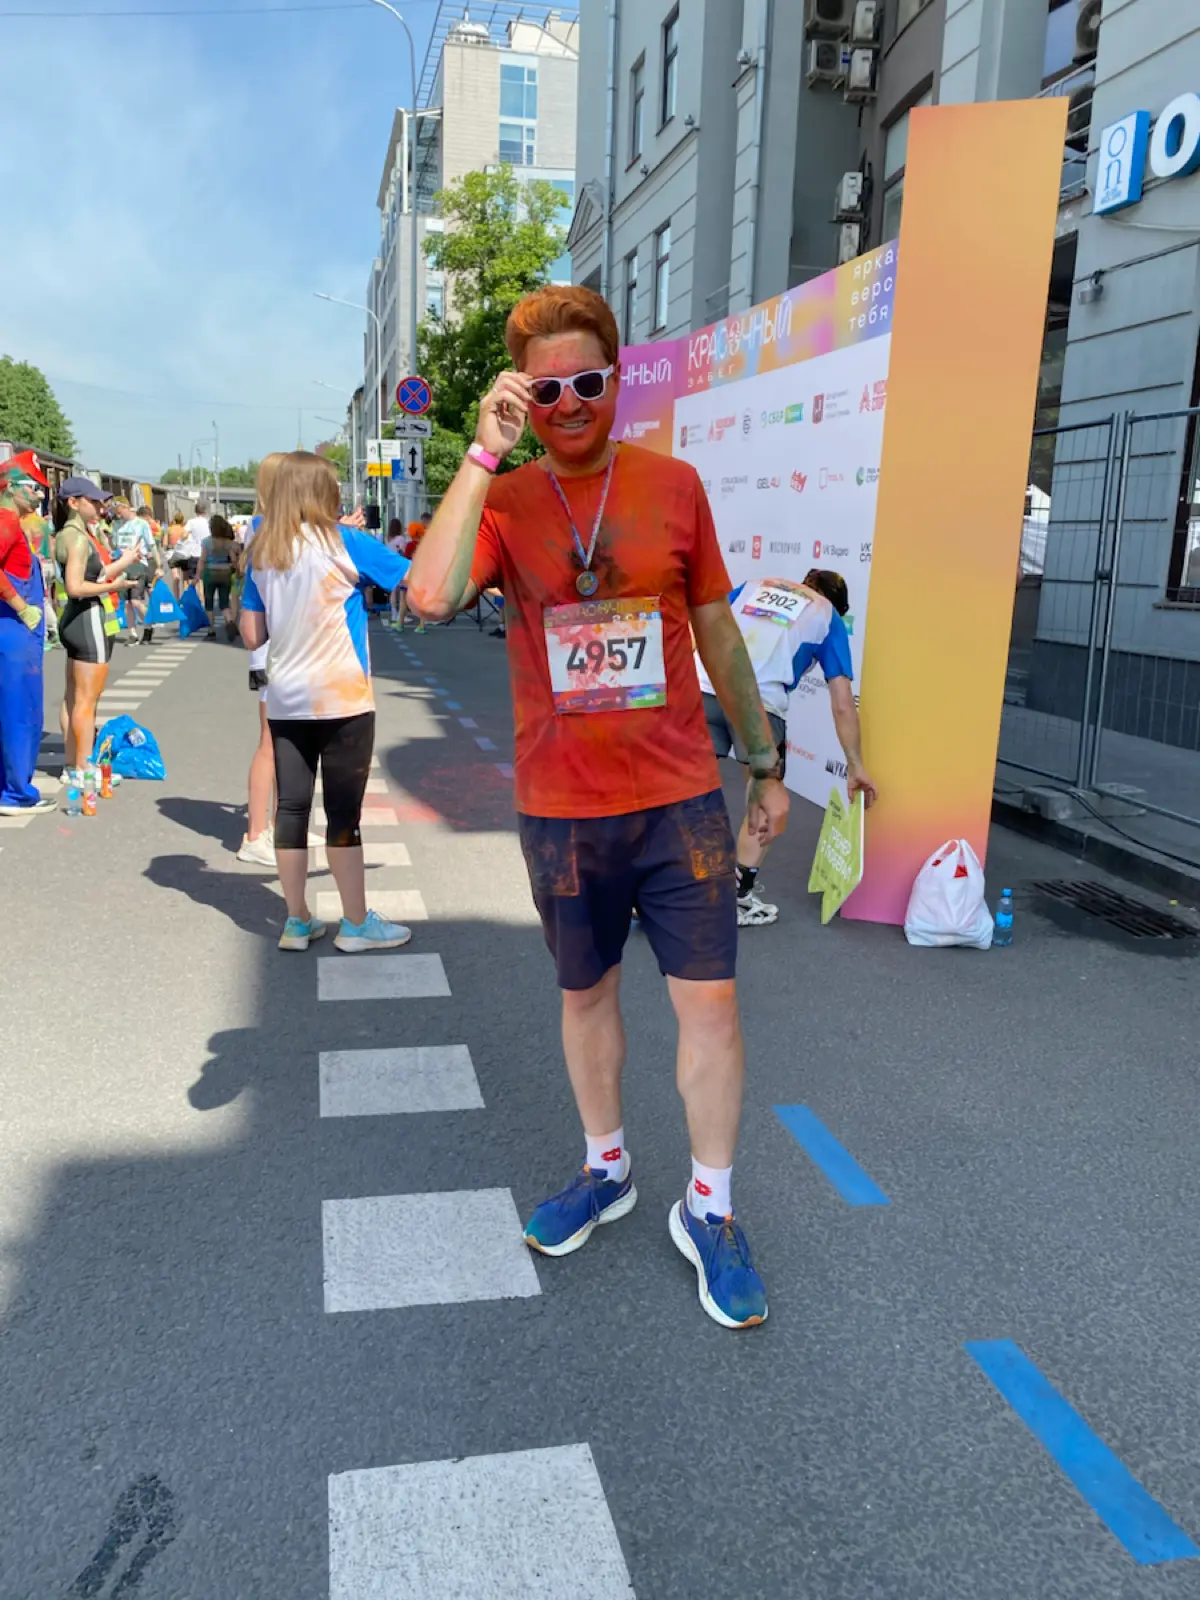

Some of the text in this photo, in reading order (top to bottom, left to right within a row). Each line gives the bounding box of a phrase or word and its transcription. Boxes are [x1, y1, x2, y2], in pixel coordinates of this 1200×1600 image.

[854, 248, 897, 280] ярка
[848, 304, 889, 332] тебя
[687, 363, 735, 388] ЗАБЕГ
[756, 591, 798, 611] 2902
[566, 636, 647, 673] 4957
